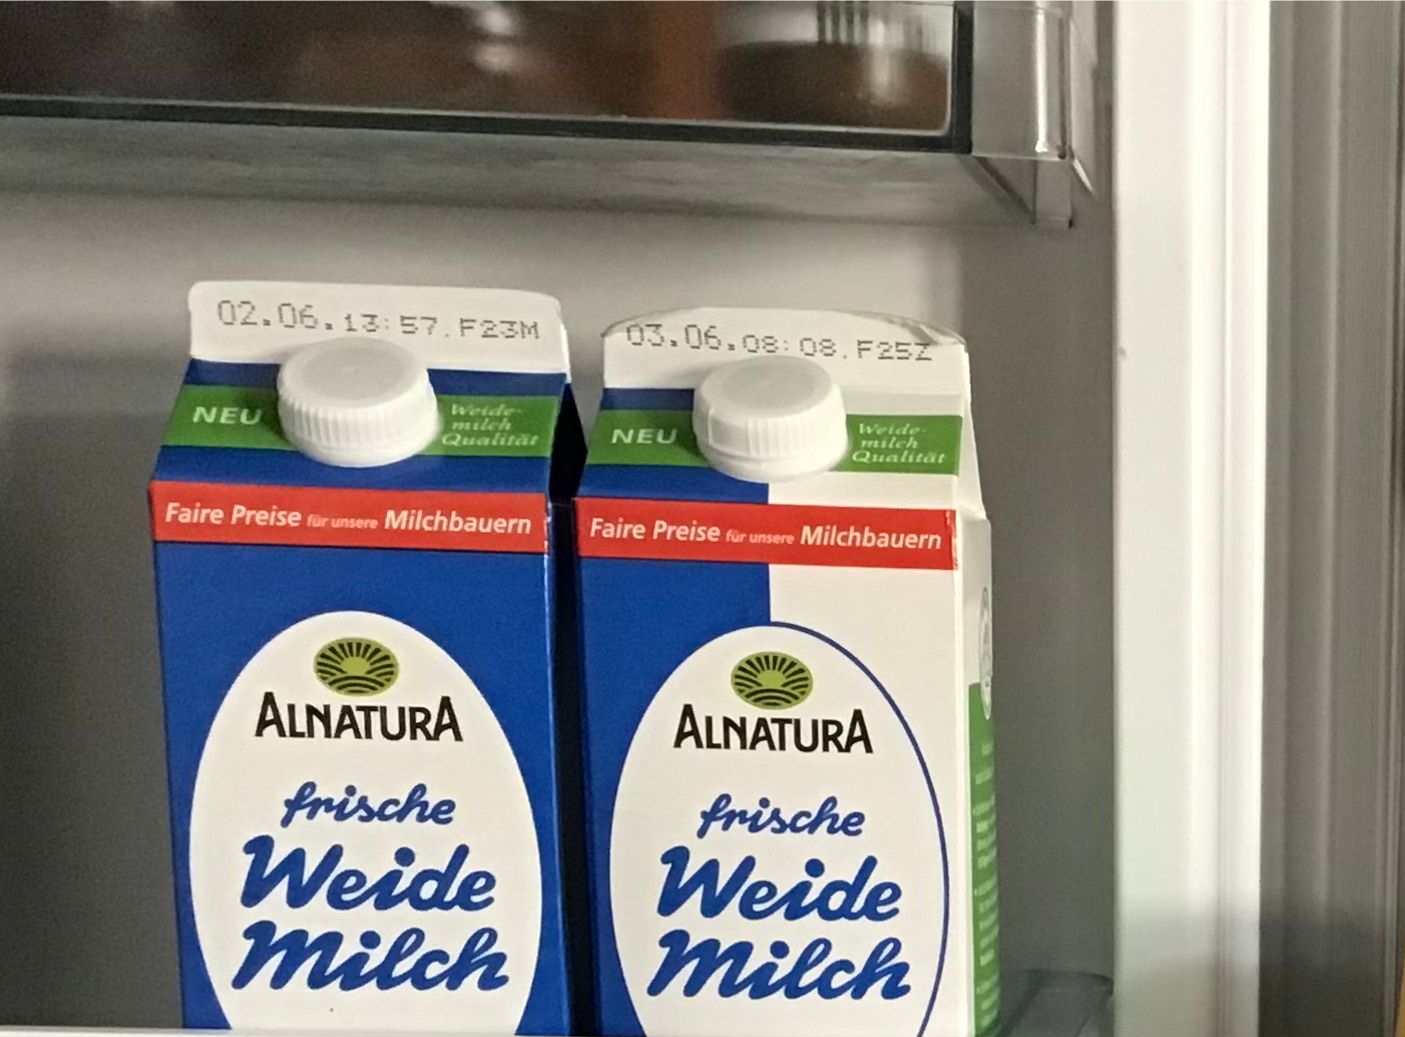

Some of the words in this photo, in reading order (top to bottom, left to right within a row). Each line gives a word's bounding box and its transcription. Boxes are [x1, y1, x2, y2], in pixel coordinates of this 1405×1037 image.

[192, 405, 263, 426] NEU
[452, 417, 512, 431] milch
[441, 432, 540, 447] Qualität
[611, 427, 678, 446] NEU
[860, 436, 919, 449] milch
[851, 450, 946, 464] Qualität
[165, 501, 225, 525] Faire
[231, 504, 303, 528] Preise
[306, 514, 329, 528] für
[330, 516, 379, 530] unsere
[383, 508, 533, 535] Milchbauern
[588, 517, 646, 540] Faire
[652, 519, 721, 542] Preise
[725, 529, 749, 544] für
[749, 532, 795, 545] unsere
[799, 524, 942, 550] Milchbauern
[254, 691, 464, 742] ALNATURA
[673, 703, 874, 754] ALNATURA
[280, 781, 457, 829] frische
[696, 793, 866, 839] frische
[239, 834, 497, 912] Weide
[656, 845, 903, 922] Weide
[231, 919, 510, 992] Milch
[646, 928, 911, 1000] Milch
